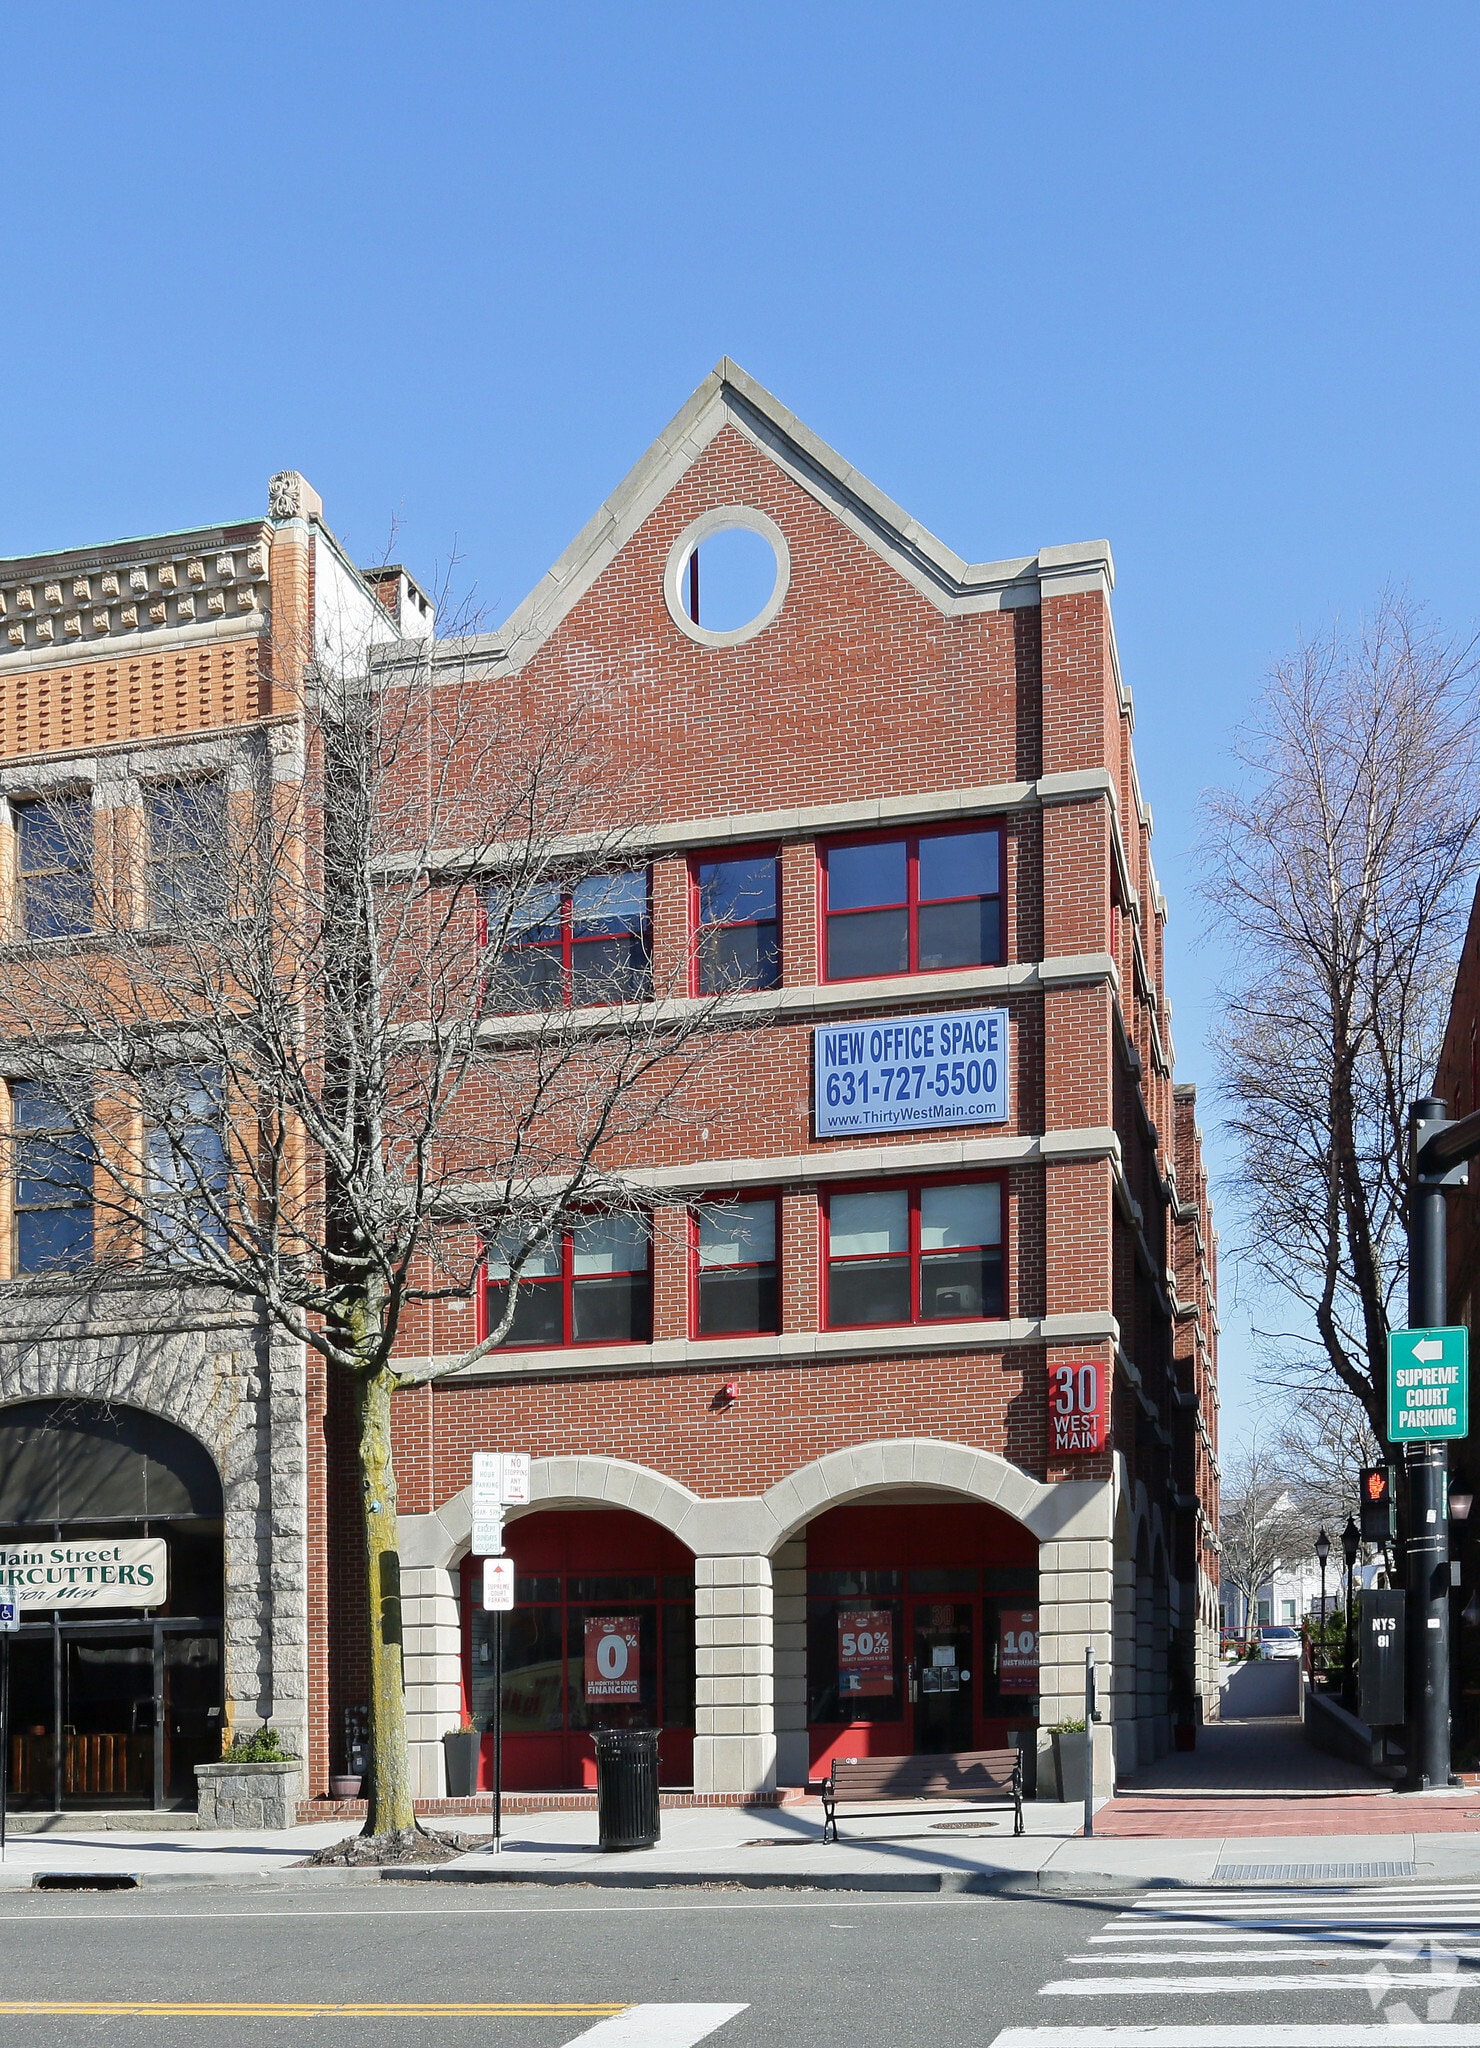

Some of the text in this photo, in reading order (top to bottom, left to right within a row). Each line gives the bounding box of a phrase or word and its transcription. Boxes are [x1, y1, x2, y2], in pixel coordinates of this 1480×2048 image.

[825, 1018, 999, 1067] NEW OFFICE SPACE
[826, 1058, 998, 1107] 631-727-5500
[827, 1103, 997, 1127] www.ThirtyWestMain.com
[1396, 1366, 1459, 1387] SUPREME
[1056, 1365, 1096, 1414] 30
[1406, 1387, 1449, 1408] COURT
[1053, 1414, 1100, 1433] WEST
[1399, 1407, 1457, 1428] PARKING
[1056, 1431, 1098, 1450] MAIN
[482, 1460, 493, 1468] TWO
[510, 1458, 521, 1468] NO
[477, 1525, 495, 1533] EXCEPT
[50, 1546, 121, 1564] Street
[46, 1586, 98, 1601] Men
[1372, 1618, 1396, 1631] NYS
[874, 1646, 889, 1654] OFF
[1377, 1635, 1389, 1648] 81
[597, 1634, 637, 1679] 0%
[587, 1685, 638, 1695] FINANCING
